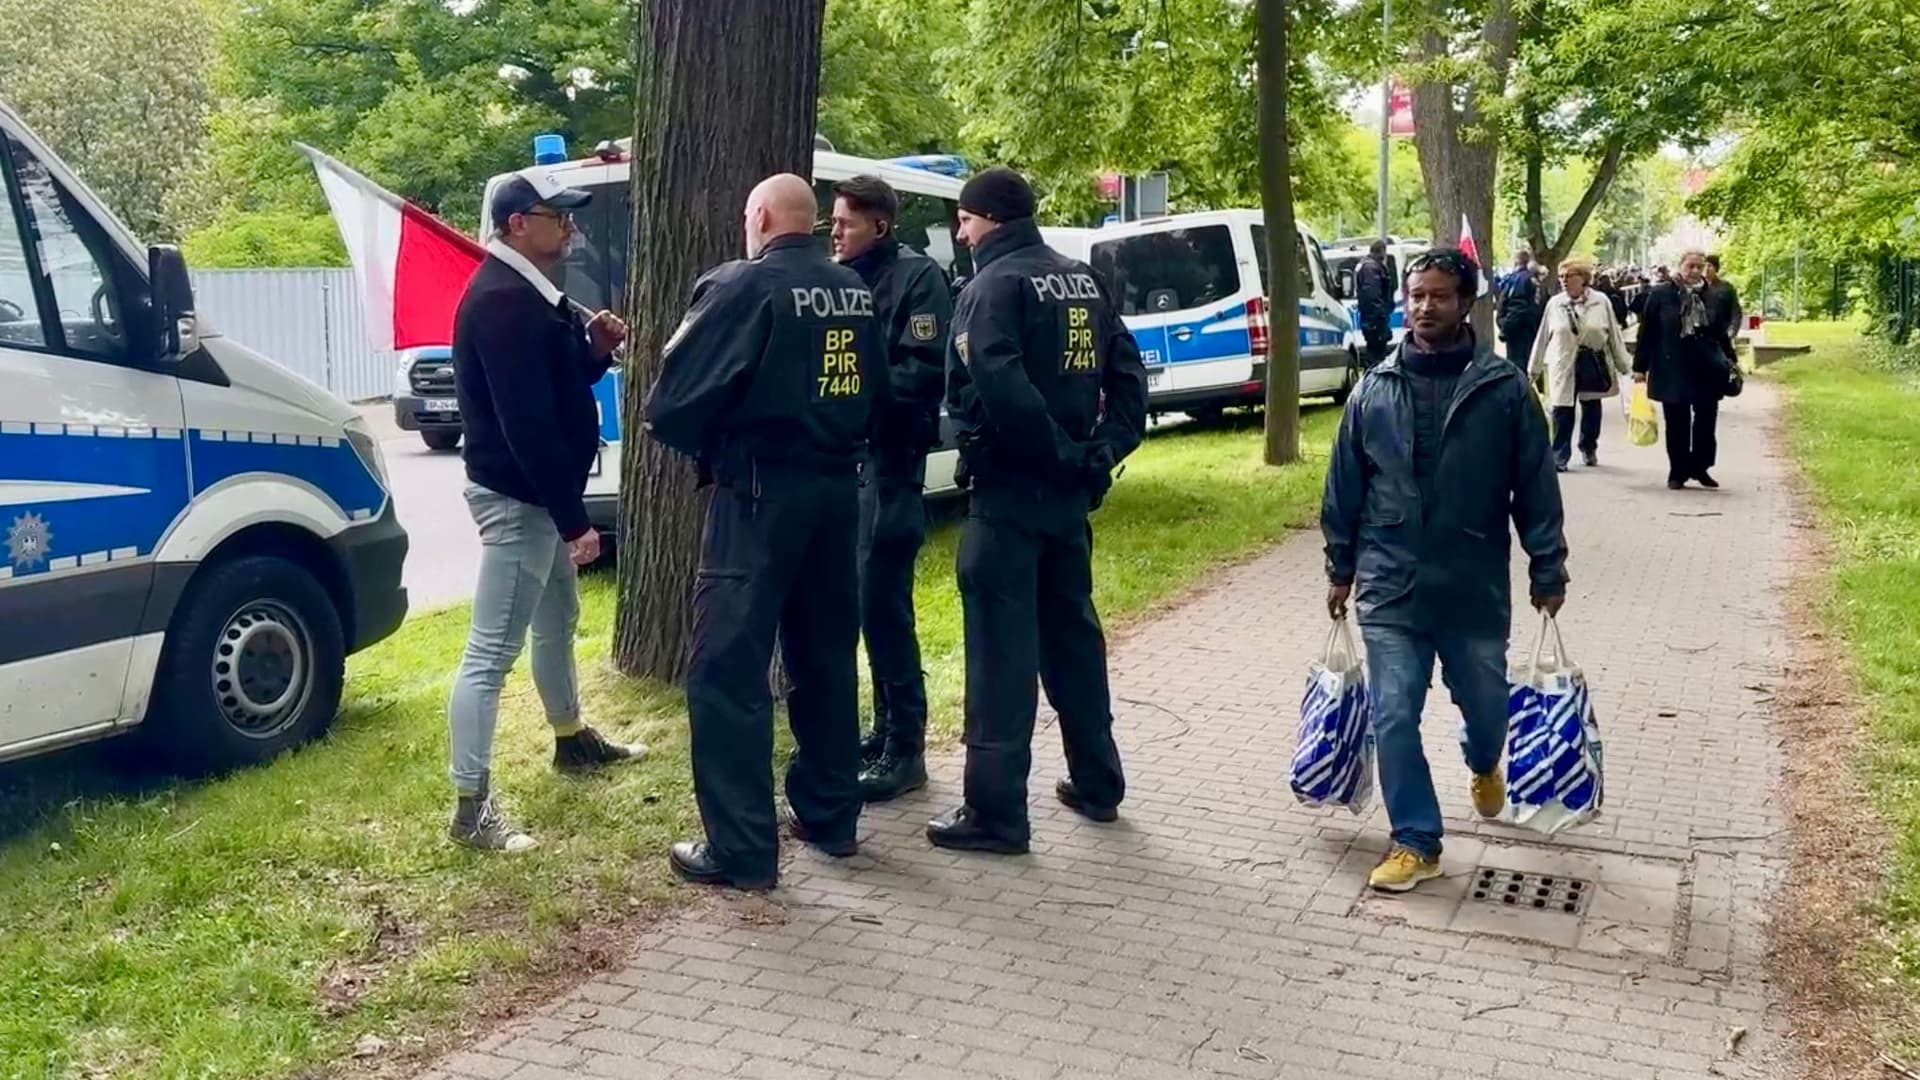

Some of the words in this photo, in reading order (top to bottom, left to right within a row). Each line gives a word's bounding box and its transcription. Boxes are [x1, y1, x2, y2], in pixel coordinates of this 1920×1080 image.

[1030, 273, 1100, 302] POLIZEI
[1068, 307, 1089, 327] BP
[825, 329, 855, 351] BP
[1068, 329, 1093, 349] PIR
[823, 352, 857, 375] PIR
[1064, 350, 1097, 370] 7441
[817, 375, 860, 398] 7440
